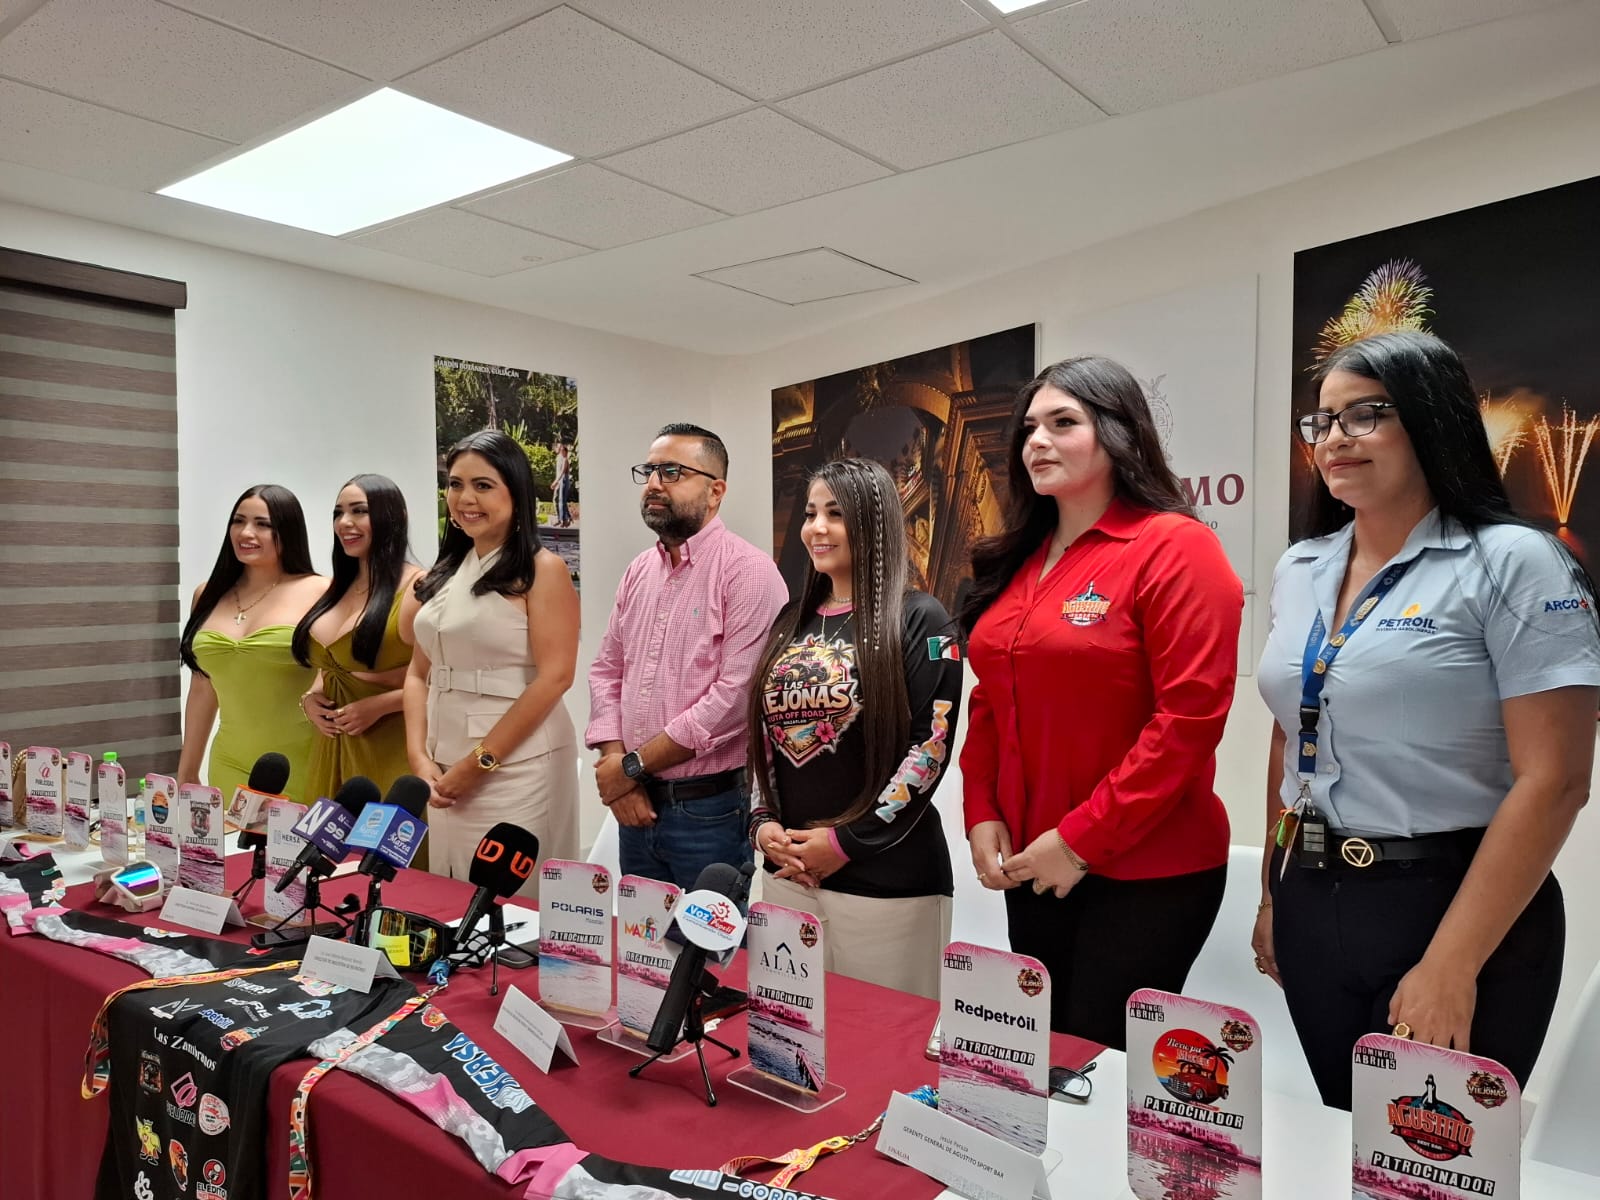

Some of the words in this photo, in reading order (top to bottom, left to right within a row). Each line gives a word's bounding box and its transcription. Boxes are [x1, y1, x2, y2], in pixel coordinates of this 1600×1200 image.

[1377, 617, 1437, 630] PETROIL
[783, 681, 803, 690] LAS
[785, 711, 800, 719] OFF
[801, 710, 825, 718] ROAD
[551, 901, 604, 917] POLARIS
[690, 905, 710, 922] Voz
[550, 930, 604, 945] PATROCINADOR
[626, 951, 673, 969] ORGANIZADOR
[760, 951, 809, 979] ALAS
[757, 985, 814, 1009] PATROCINADOR
[1130, 1008, 1156, 1021] ABRIL
[154, 1026, 169, 1046] Las
[170, 1035, 217, 1071] Zambranos
[954, 1036, 1036, 1066] PATROCINADOR
[1356, 1045, 1395, 1060] DOMINGO
[1355, 1053, 1386, 1069] ABRIL
[1389, 1059, 1397, 1070] 5
[1468, 1085, 1507, 1098] VIEJONAS
[1144, 1095, 1244, 1129] PATROCINADOR
[1386, 1103, 1475, 1147] AGUSTITO
[903, 1125, 923, 1140] GERENTE
[924, 1133, 945, 1150] GENERAL
[945, 1146, 953, 1154] DE
[952, 1149, 977, 1167] AGUSTITO
[993, 1168, 1005, 1179] BAR
[1371, 1151, 1495, 1196] PATROCINADOR
